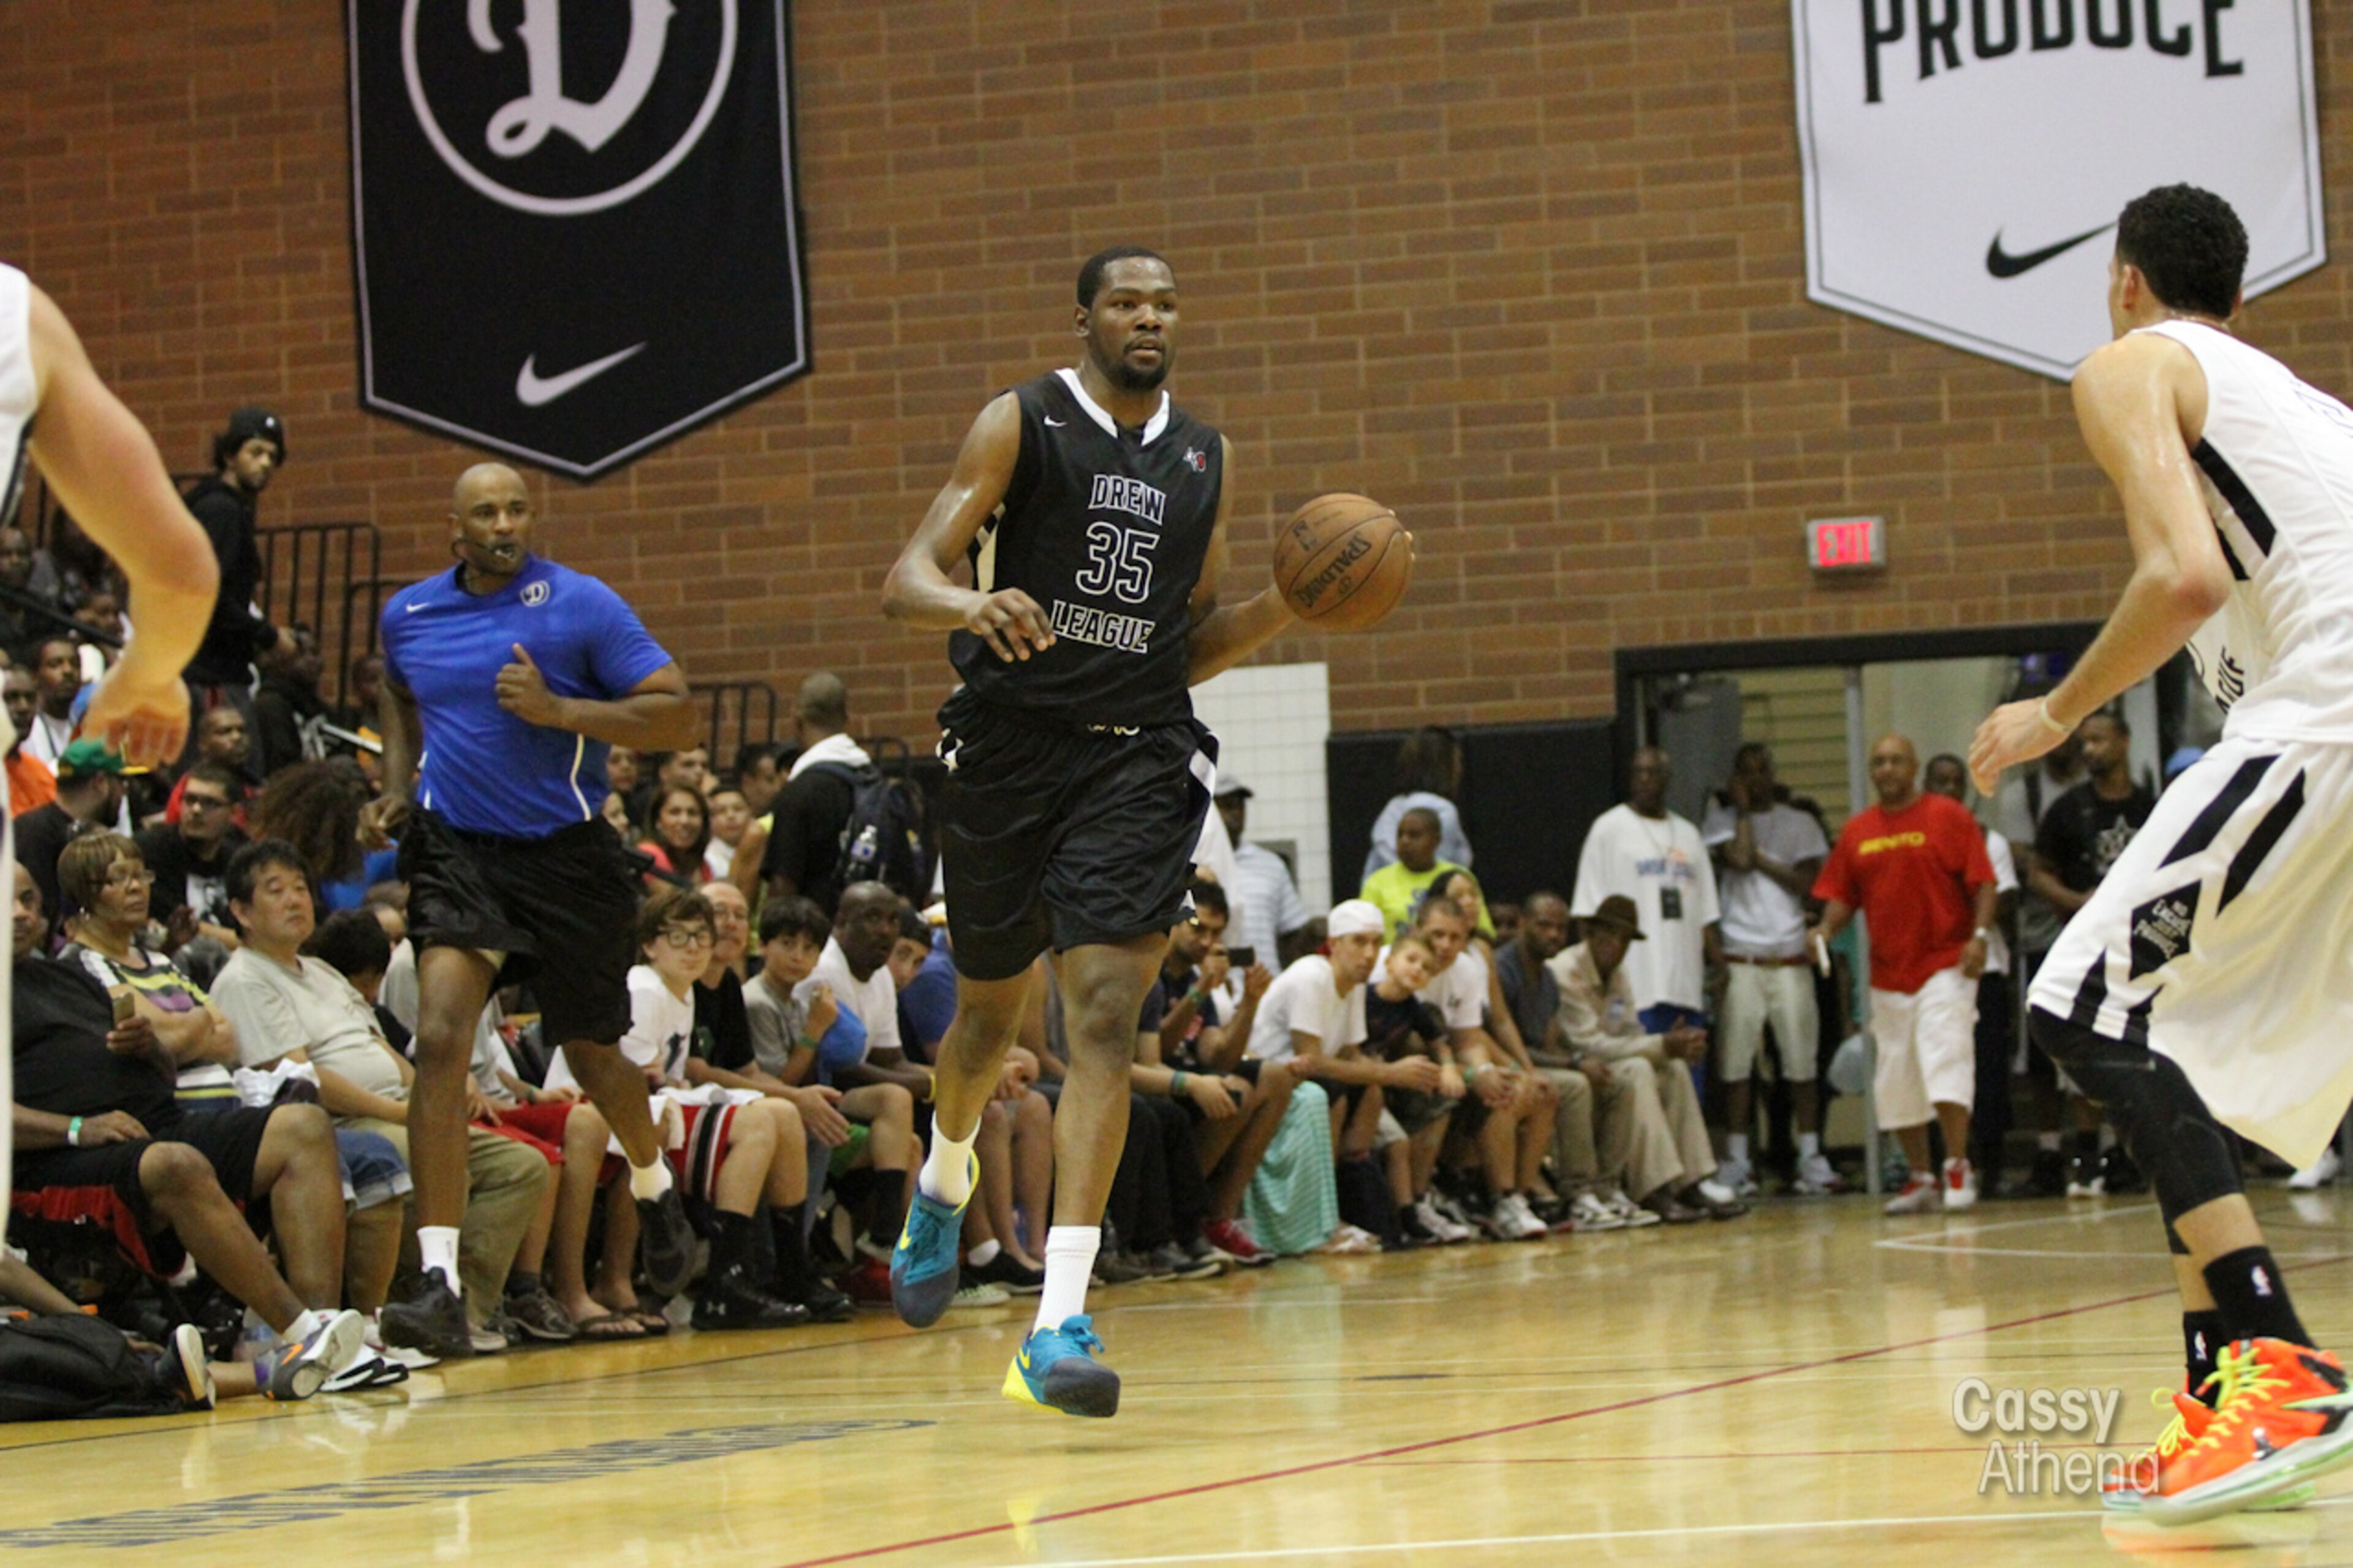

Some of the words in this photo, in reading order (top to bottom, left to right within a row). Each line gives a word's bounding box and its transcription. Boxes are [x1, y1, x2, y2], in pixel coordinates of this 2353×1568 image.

[1088, 474, 1166, 526] DREW
[1075, 521, 1160, 604] 35
[1292, 530, 1372, 608] SPALDING
[1817, 521, 1873, 567] EXIT
[1051, 599, 1156, 654] LEAGUE
